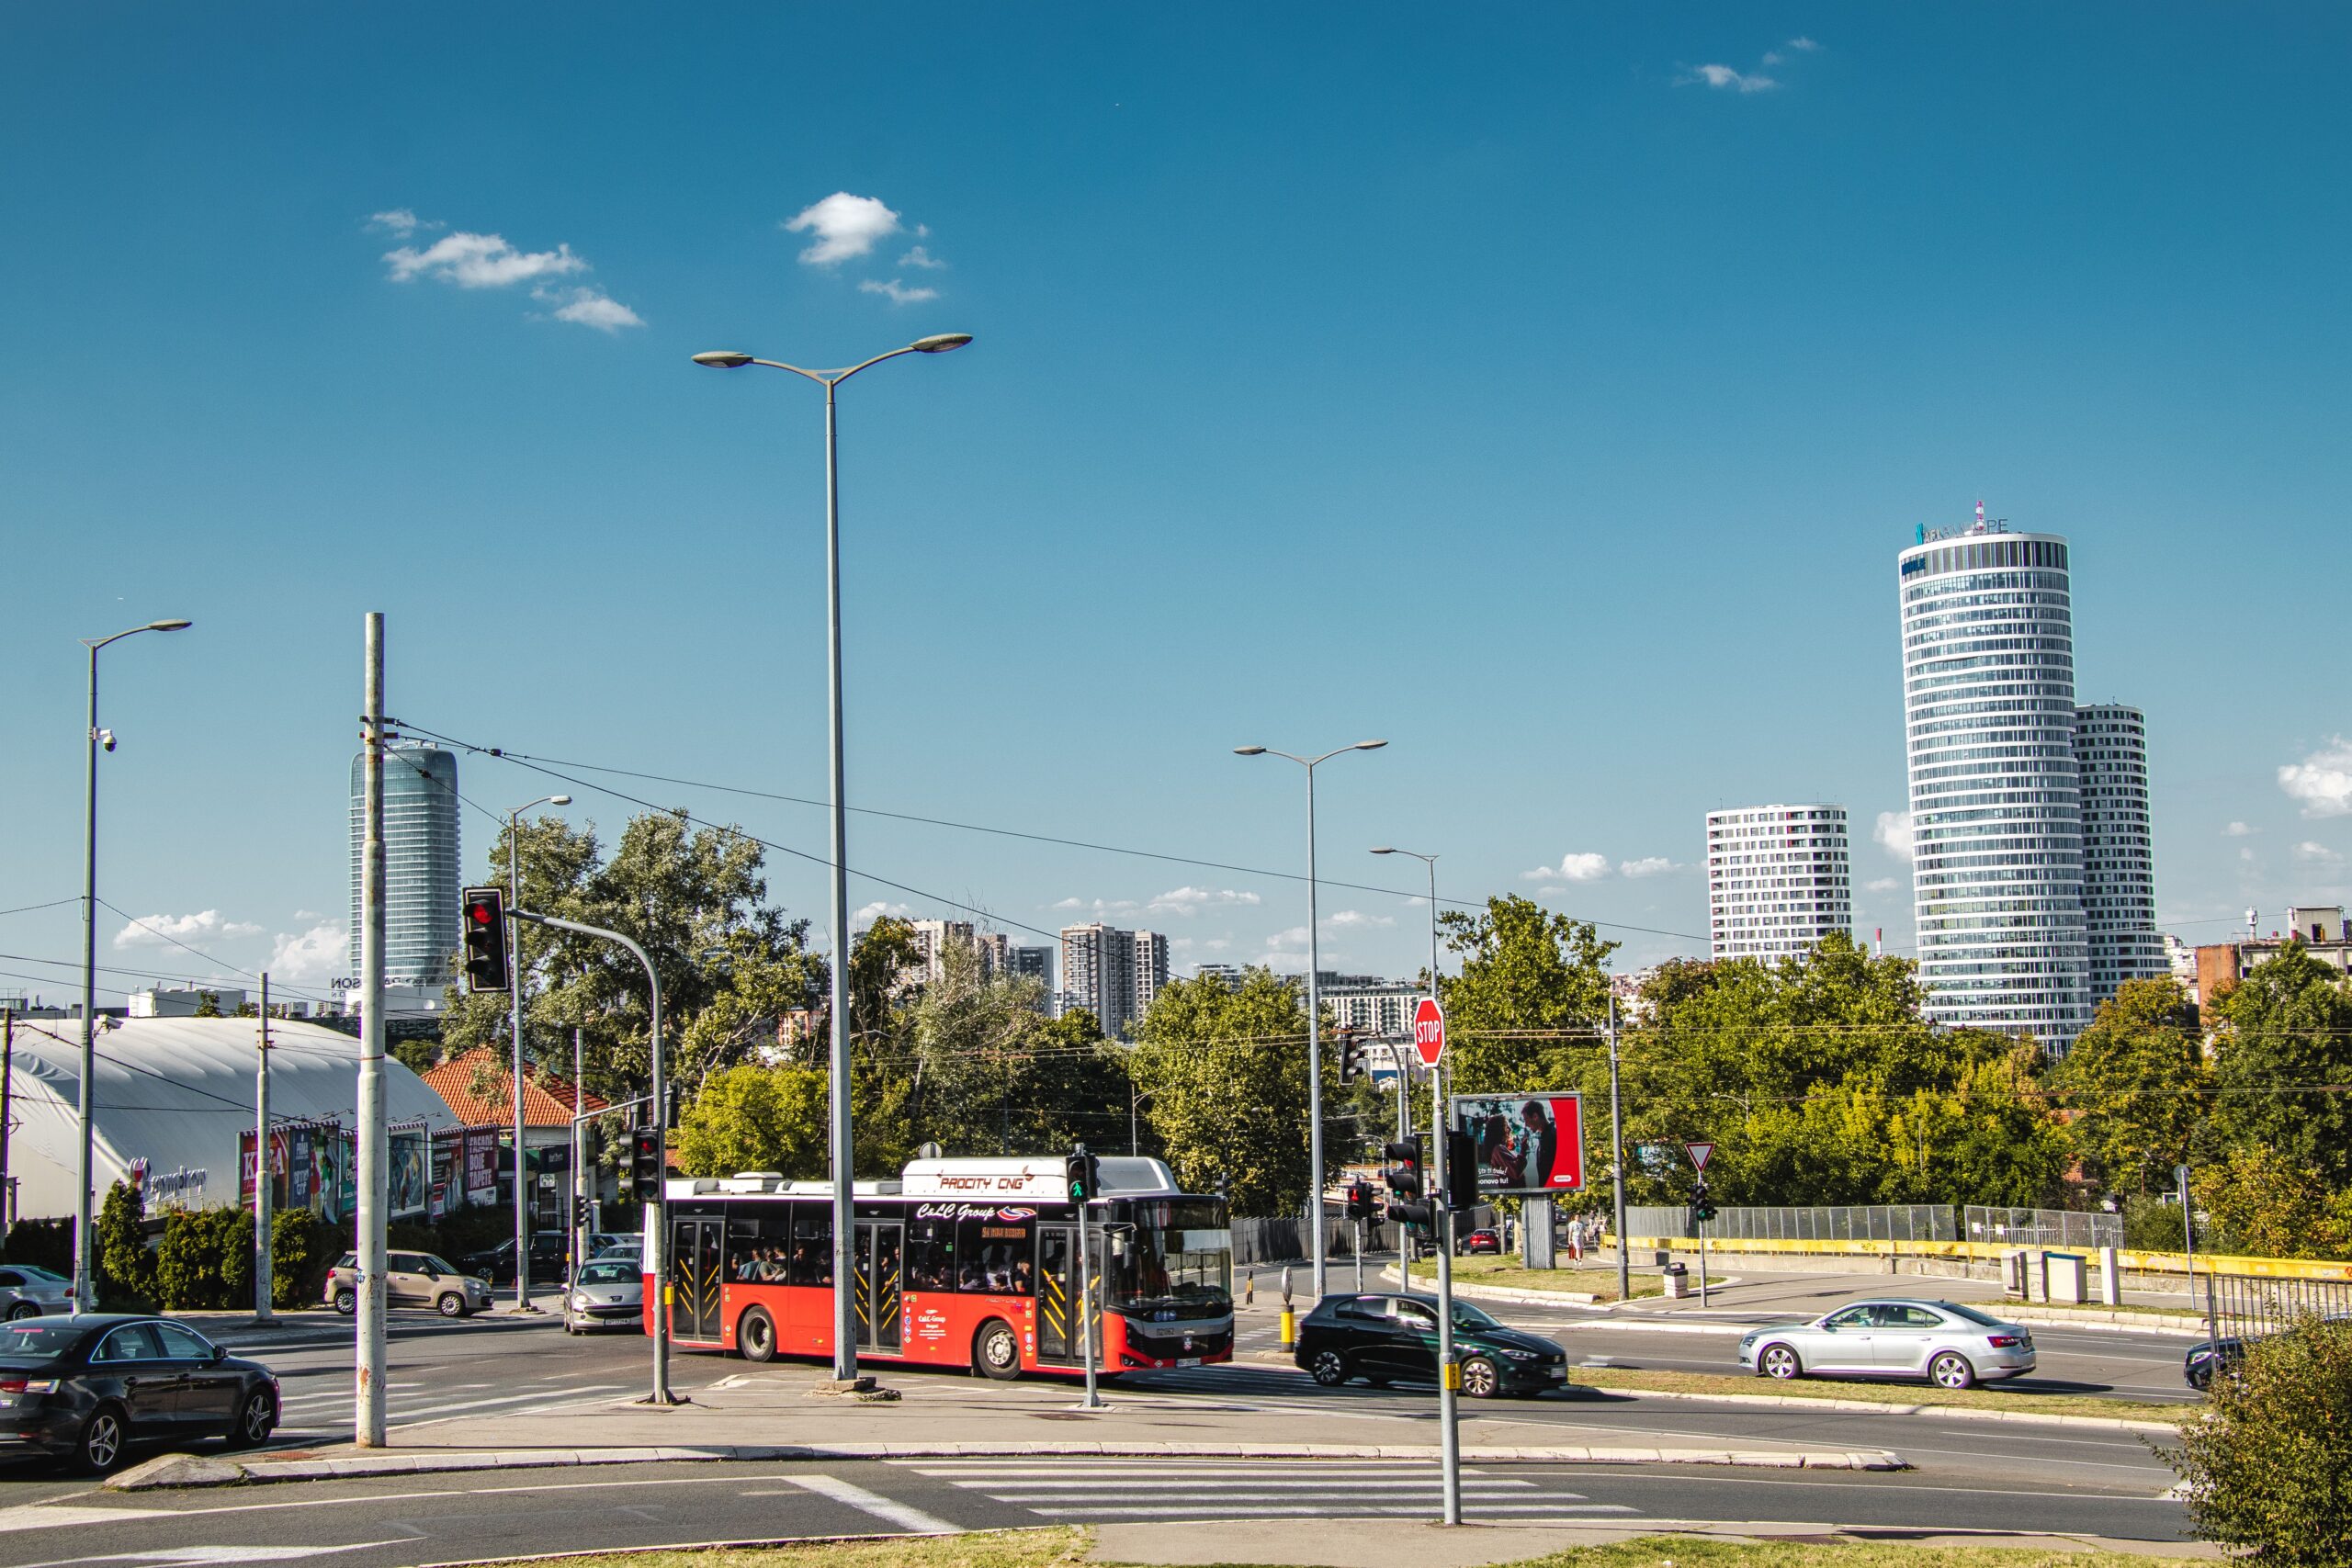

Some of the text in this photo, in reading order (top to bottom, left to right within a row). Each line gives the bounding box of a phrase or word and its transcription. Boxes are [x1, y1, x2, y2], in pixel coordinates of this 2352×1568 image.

[1418, 1021, 1440, 1043] STOP
[469, 1168, 492, 1189] TAPETE
[939, 1178, 1023, 1190] PROCITY CNG
[917, 1203, 996, 1221] C&LC Group
